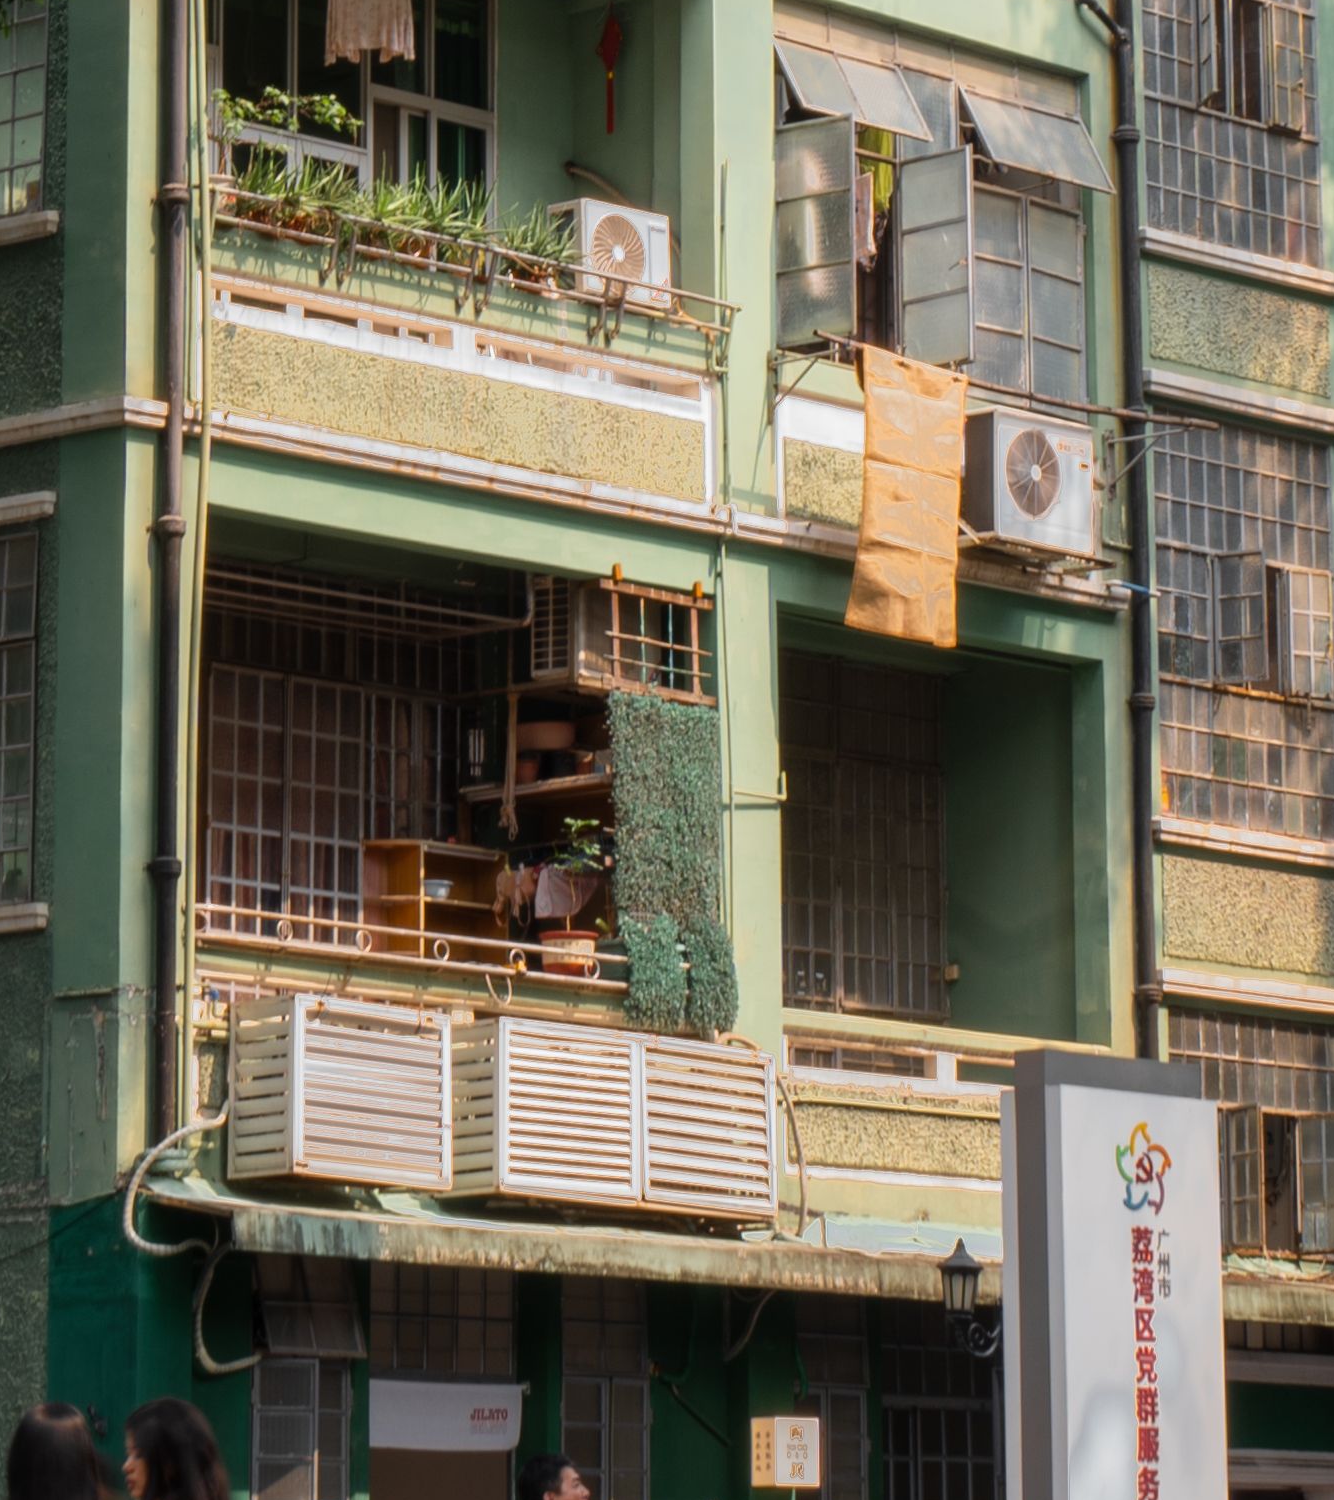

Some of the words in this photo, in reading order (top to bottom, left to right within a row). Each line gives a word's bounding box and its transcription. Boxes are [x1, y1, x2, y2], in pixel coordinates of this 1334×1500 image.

[1157, 1229, 1171, 1299] 广州市
[470, 1407, 508, 1421] JILATO
